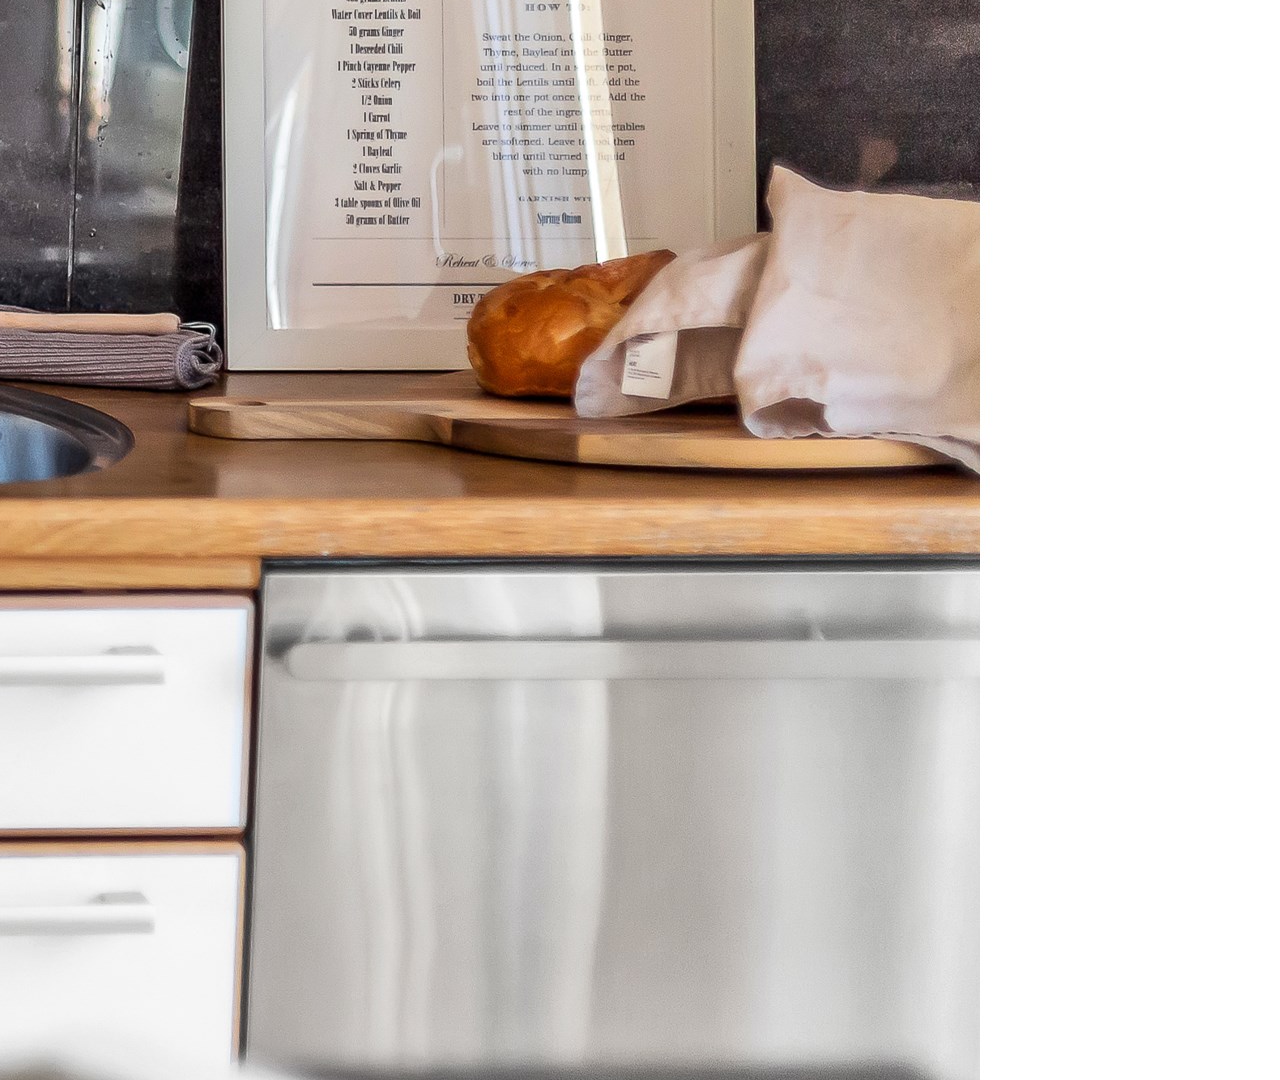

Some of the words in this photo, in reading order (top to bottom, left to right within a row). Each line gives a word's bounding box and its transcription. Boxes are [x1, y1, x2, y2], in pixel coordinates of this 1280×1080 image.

[332, 9, 352, 19] Water
[354, 9, 372, 19] Cover
[375, 9, 398, 19] Lentils
[400, 10, 405, 19] &
[408, 9, 421, 19] Boil
[349, 26, 357, 36] 50
[359, 29, 380, 37] grams
[382, 26, 404, 37] Ginger
[483, 33, 511, 41] Sweat
[533, 34, 565, 42] Onion,
[598, 33, 633, 43] Ginger,
[350, 44, 353, 54] 1
[356, 44, 385, 54] Deseeded
[388, 43, 403, 54] Chili
[483, 48, 519, 58] Thyme,
[522, 48, 558, 58] Bayleaf
[338, 61, 340, 71] 1
[343, 61, 361, 71] Pinch
[364, 61, 390, 73] Cayenne
[393, 61, 416, 73] Pepper
[481, 63, 502, 71] until
[505, 63, 547, 71] reduced.
[552, 63, 561, 71] In
[618, 63, 636, 73] pot,
[352, 78, 356, 88] 2
[358, 78, 379, 88] Sticks
[381, 78, 401, 90] Celery
[477, 78, 494, 86] boil
[498, 78, 513, 86] the
[517, 78, 548, 86] Lentils
[553, 78, 575, 86] until
[602, 78, 621, 86] Add
[625, 78, 640, 86] the
[362, 95, 371, 105] 1/2
[374, 95, 392, 105] Onion
[534, 94, 549, 102] pot
[609, 93, 626, 101] Add
[630, 93, 646, 101] the
[364, 112, 366, 122] 1
[369, 112, 390, 122] Carrot
[525, 108, 535, 116] of
[537, 108, 552, 116] the
[347, 129, 350, 139] 1
[352, 129, 374, 142] Spring
[377, 129, 383, 139] of
[385, 129, 407, 142] Thyme
[548, 138, 575, 146] Leave
[614, 137, 635, 146] then
[363, 146, 365, 156] 1
[368, 146, 392, 158] Bayleaf
[493, 152, 519, 161] blend
[523, 152, 545, 160] until
[549, 152, 582, 160] turned
[353, 163, 357, 174] 2
[359, 163, 380, 173] Cloves
[382, 163, 402, 174] Garlic
[523, 167, 542, 175] with
[354, 180, 367, 190] Salt
[370, 181, 375, 191] &
[378, 180, 401, 192] Pepper
[341, 197, 358, 208] table
[360, 200, 382, 210] spoons
[384, 198, 390, 208] of
[393, 197, 409, 208] Olive
[411, 197, 420, 208] Oil
[346, 214, 354, 224] 50
[356, 217, 377, 225] grams
[379, 215, 385, 225] of
[388, 215, 410, 225] Butter
[537, 212, 560, 226] Spring
[562, 212, 581, 224] Onion
[436, 253, 479, 268] Reheat
[453, 294, 475, 304] DRY
